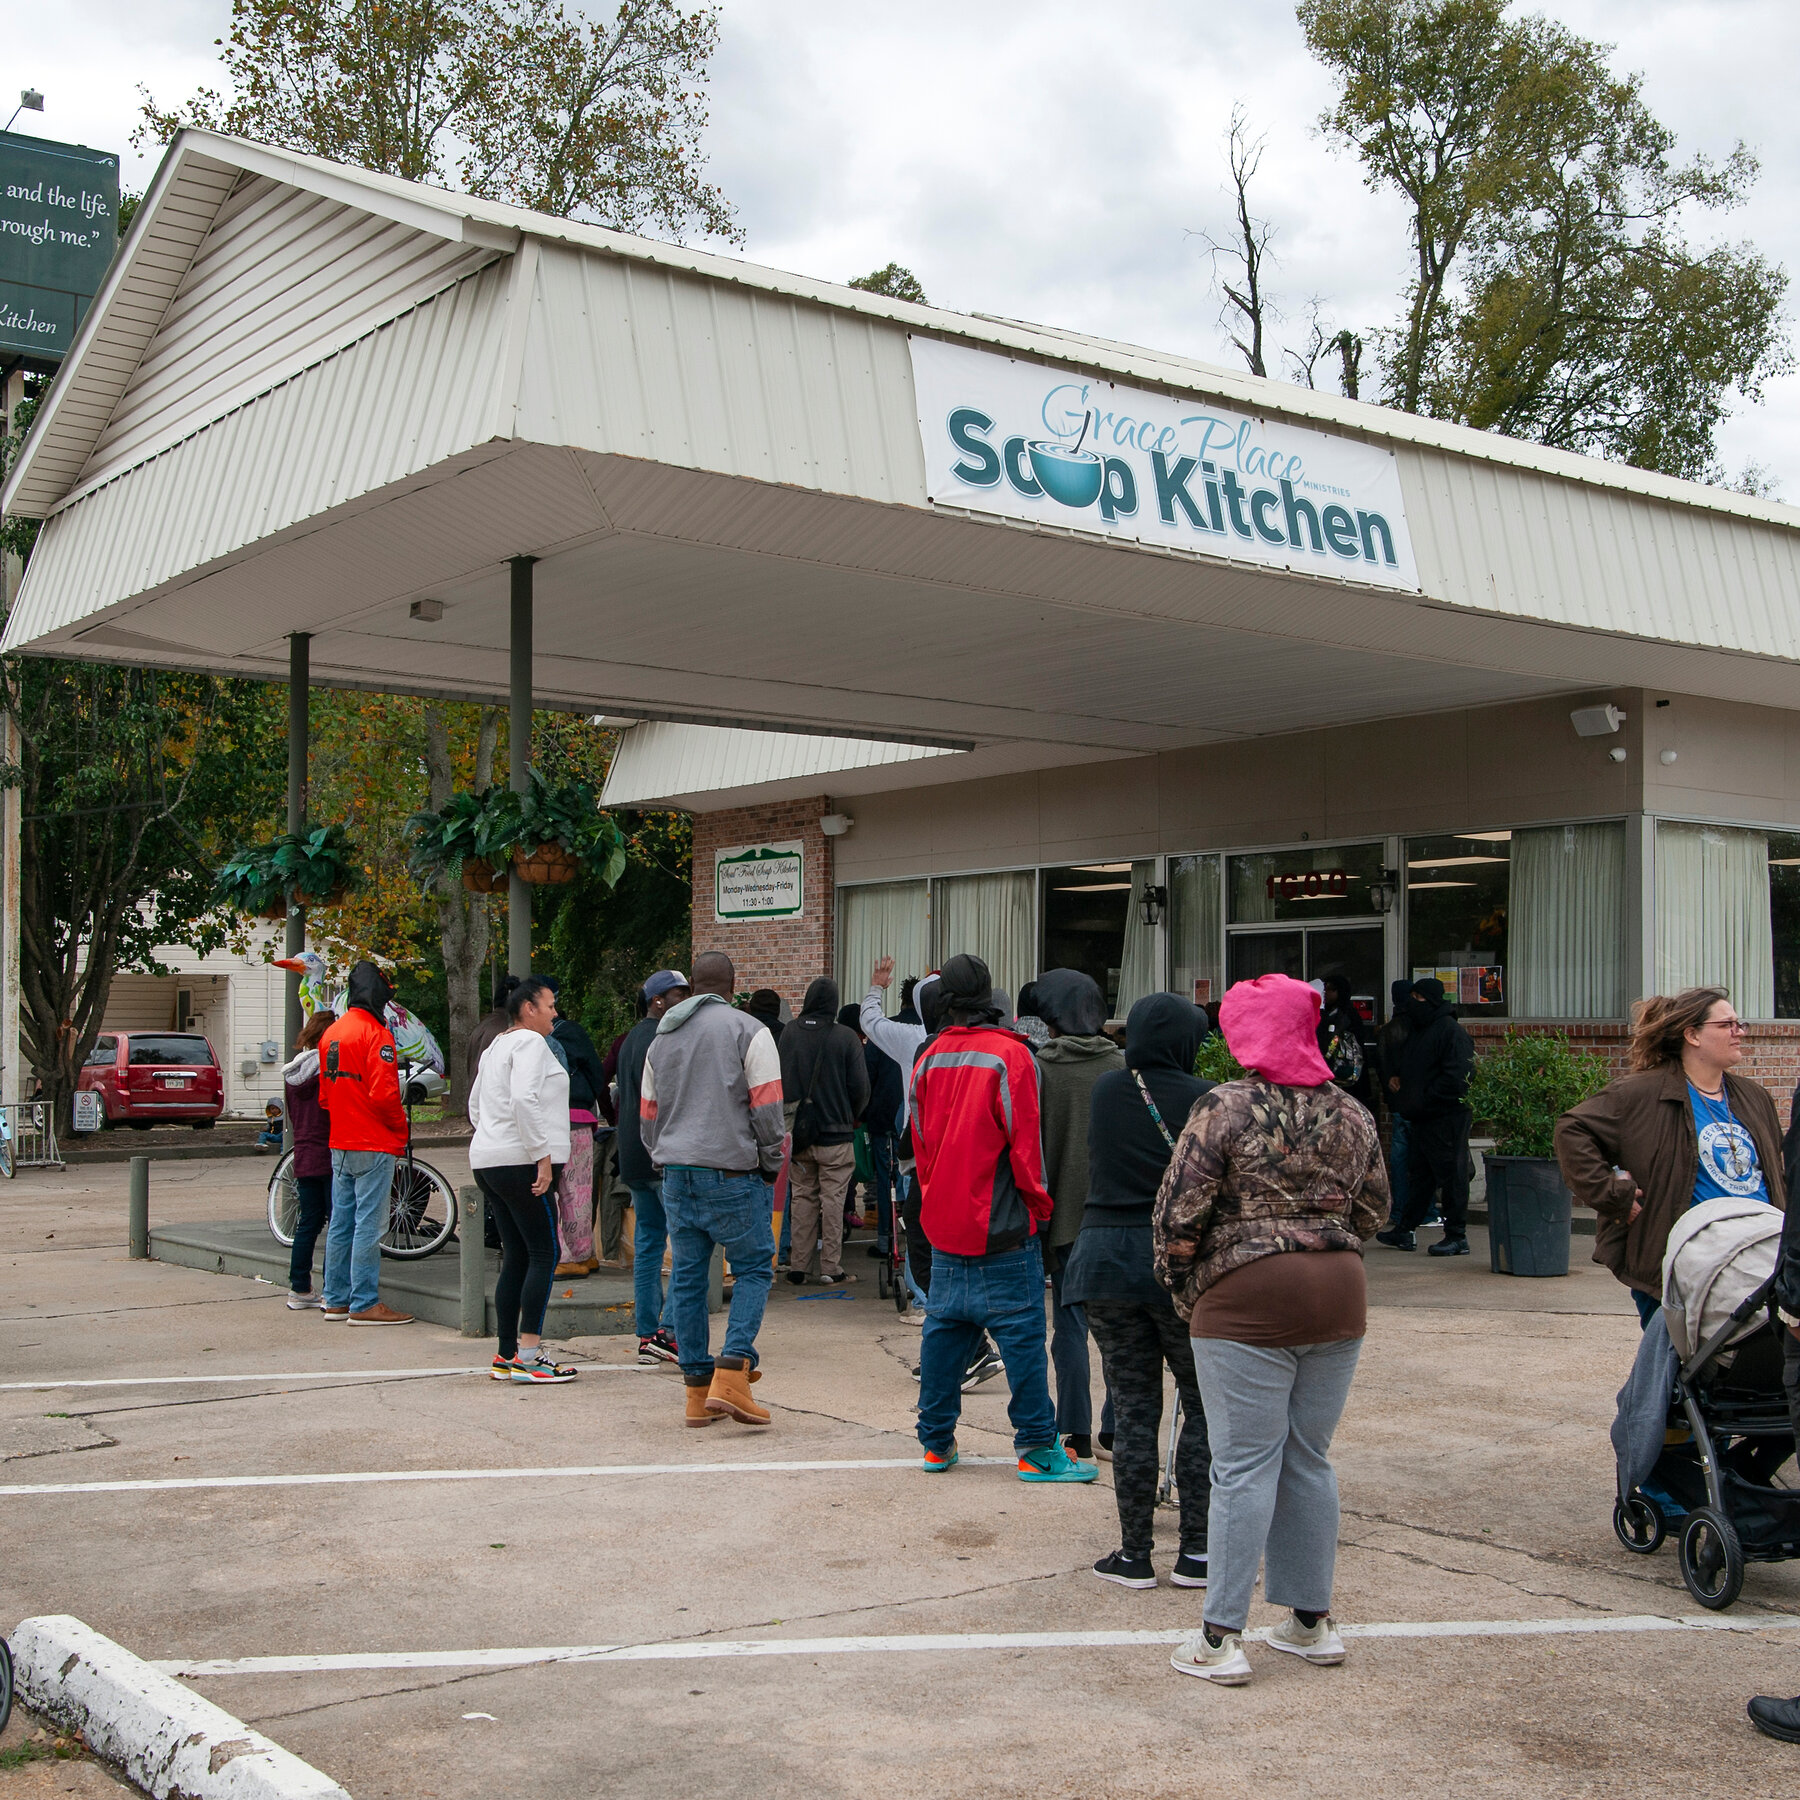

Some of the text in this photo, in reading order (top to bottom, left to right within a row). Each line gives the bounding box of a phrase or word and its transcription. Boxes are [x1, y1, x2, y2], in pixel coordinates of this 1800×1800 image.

[7, 182, 111, 219] and the life.
[0, 218, 56, 245] rough
[1042, 384, 1306, 485] Grace Place
[1302, 480, 1351, 498] MINISTRIES
[1149, 448, 1400, 568] Kitchen
[1265, 868, 1348, 899] 1600
[742, 898, 757, 907] 11:30
[761, 896, 774, 906] 1:00
[1729, 1183, 1749, 1192] THRU
